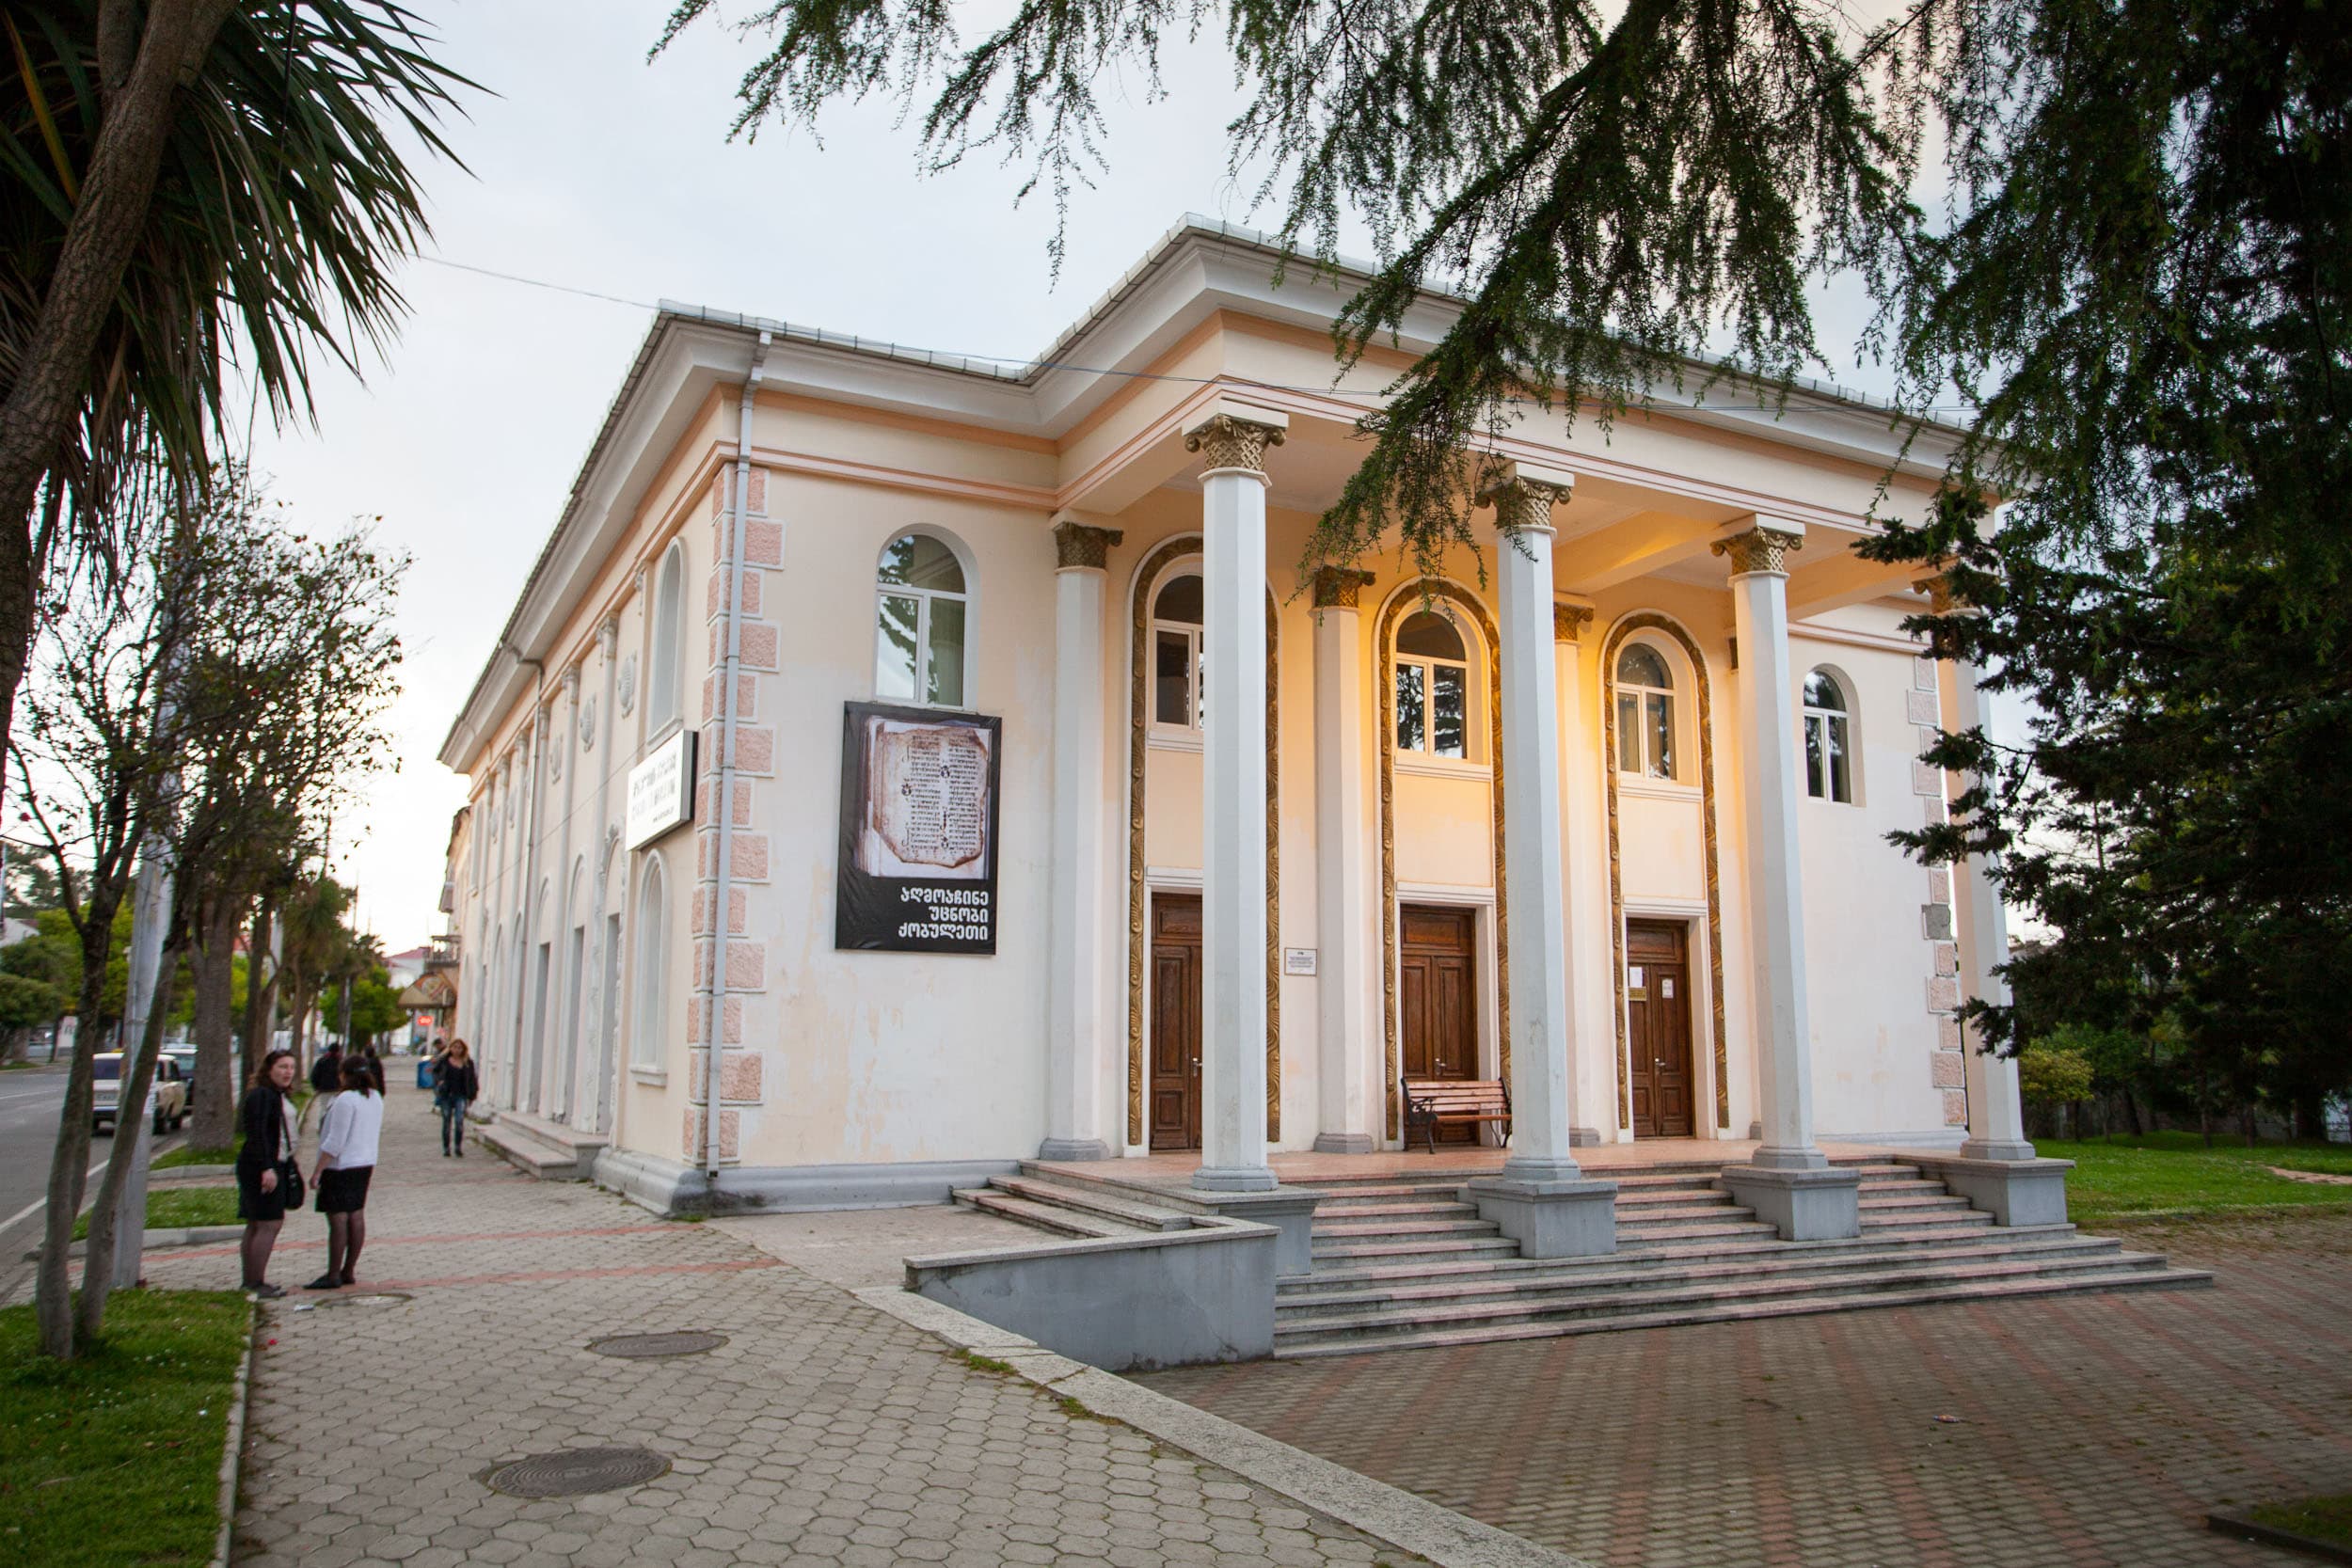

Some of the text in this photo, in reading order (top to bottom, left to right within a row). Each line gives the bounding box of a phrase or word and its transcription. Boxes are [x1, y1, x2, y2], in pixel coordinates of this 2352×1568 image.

[900, 886, 989, 906] აღმოაჩინე
[928, 905, 989, 924] უცნობი
[898, 922, 989, 941] ქობულეთი
